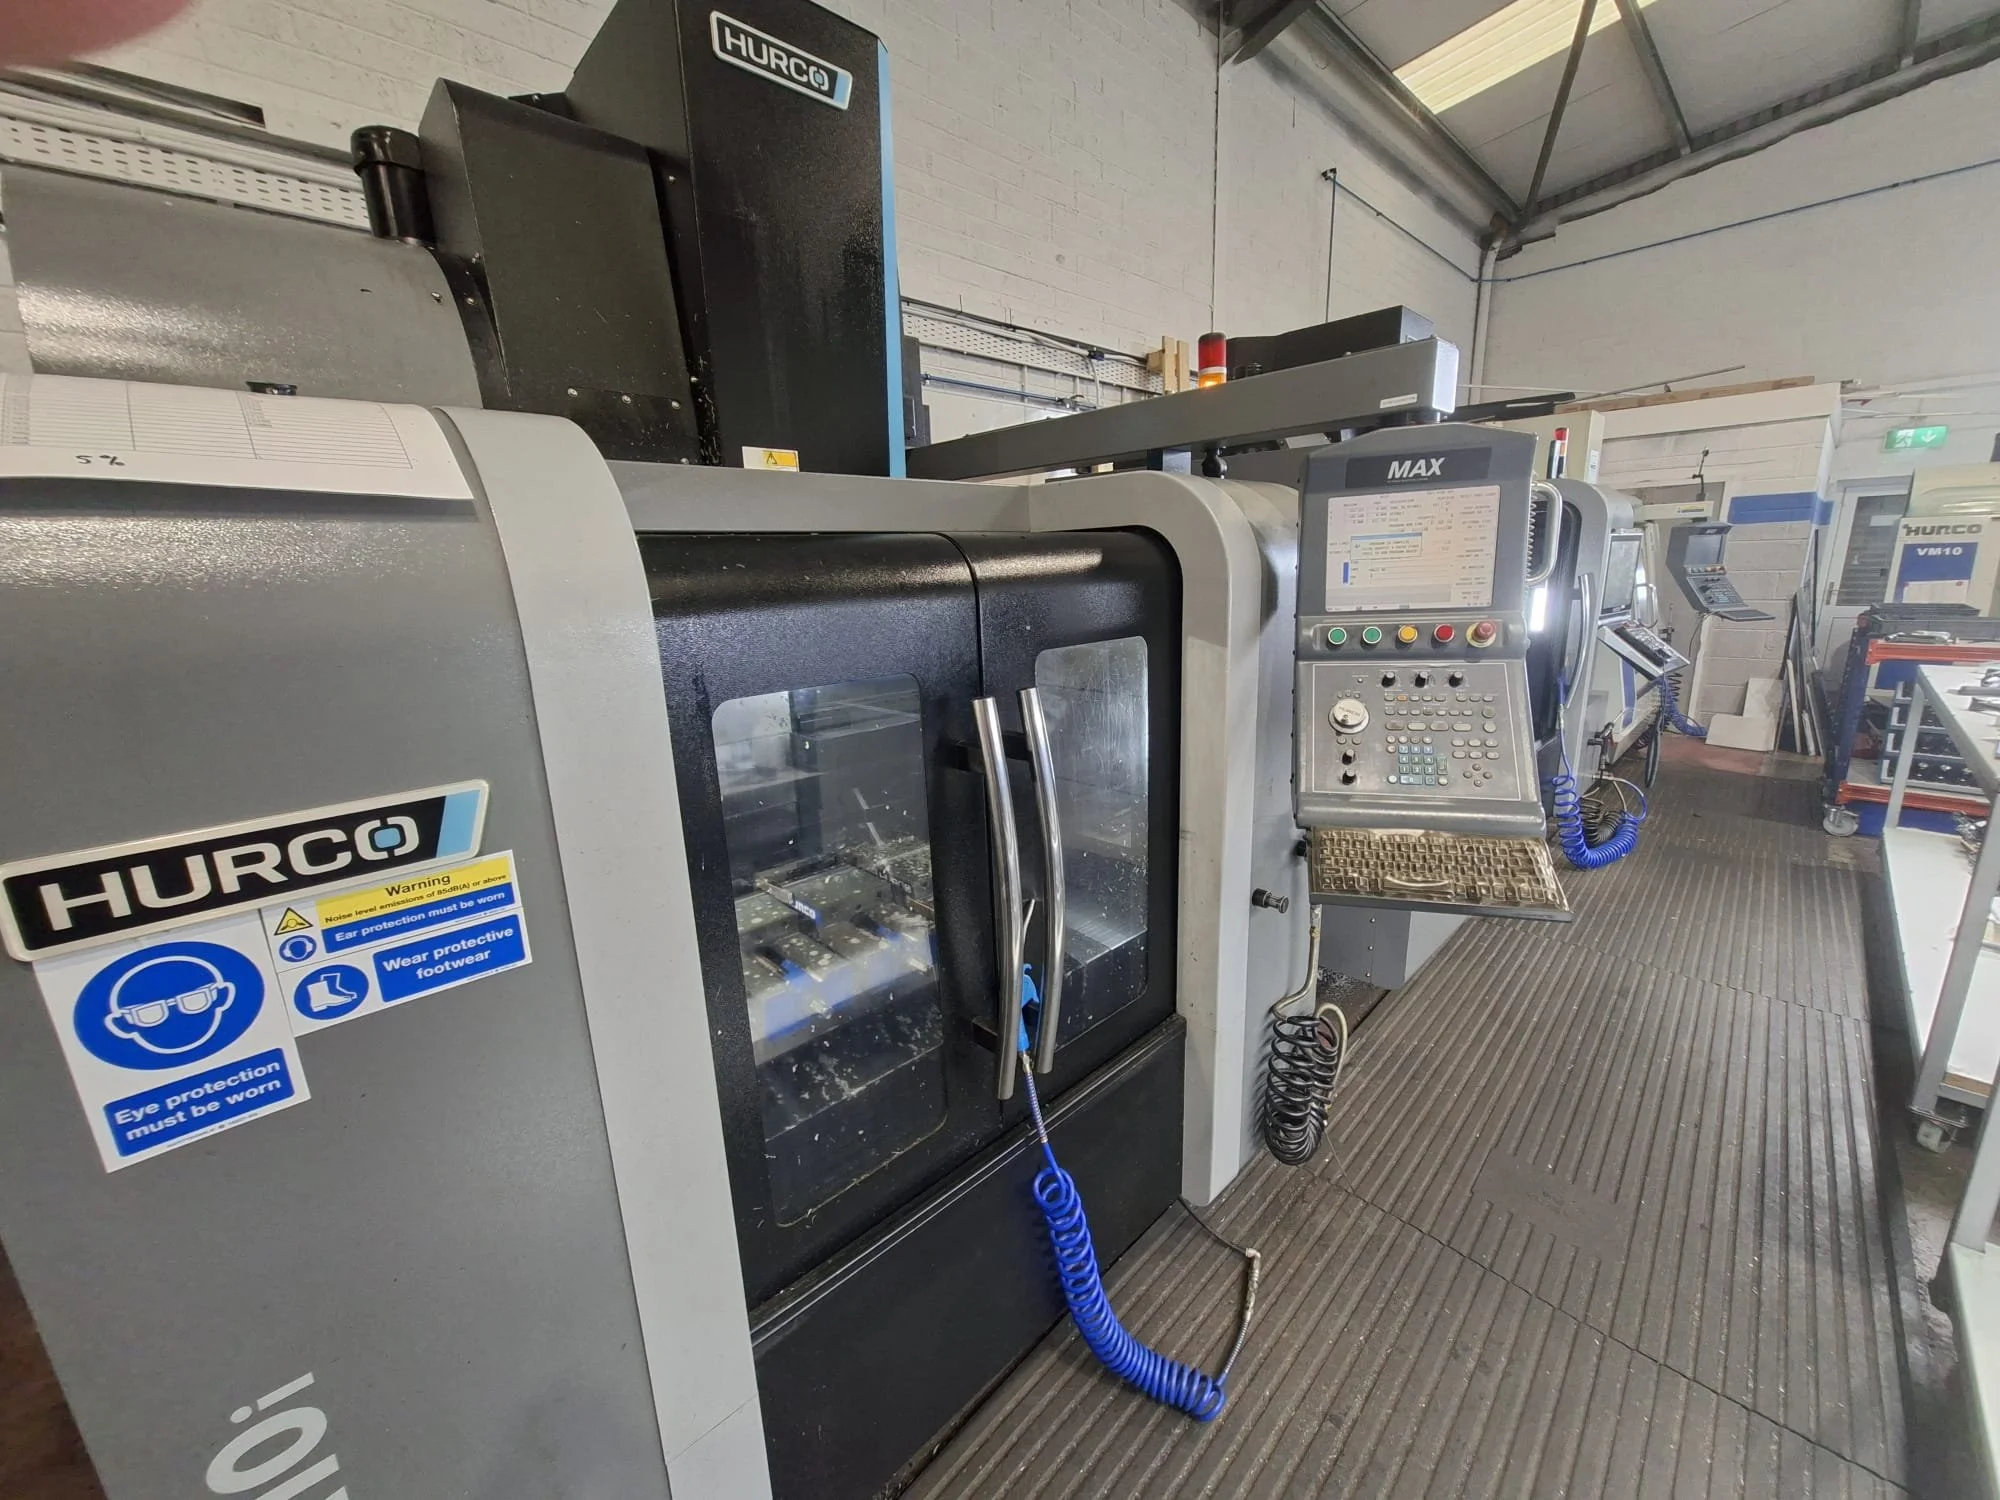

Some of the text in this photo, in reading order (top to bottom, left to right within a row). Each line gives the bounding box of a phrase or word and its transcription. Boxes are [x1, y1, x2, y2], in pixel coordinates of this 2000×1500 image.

[724, 26, 830, 92] HURCO
[1387, 456, 1447, 479] MAX
[1904, 523, 1982, 536] HURCO
[1916, 546, 1963, 556] VM10
[39, 815, 421, 932] HURCO
[386, 875, 451, 897] Warning
[325, 912, 353, 923] Noise
[355, 905, 377, 916] level
[379, 895, 424, 910] emissions
[426, 891, 436, 899] of
[437, 882, 471, 896] 85dB(A)
[482, 875, 506, 885] above
[335, 930, 358, 942] Ear
[361, 911, 426, 937] protection
[428, 904, 459, 918] must
[460, 900, 475, 909] be
[477, 892, 506, 905] worn
[382, 928, 514, 972] Wear protective
[416, 949, 491, 979] footwear
[114, 1062, 281, 1126] Eye protection
[126, 1112, 188, 1142] must
[190, 1101, 221, 1118] be
[225, 1080, 282, 1105] worn
